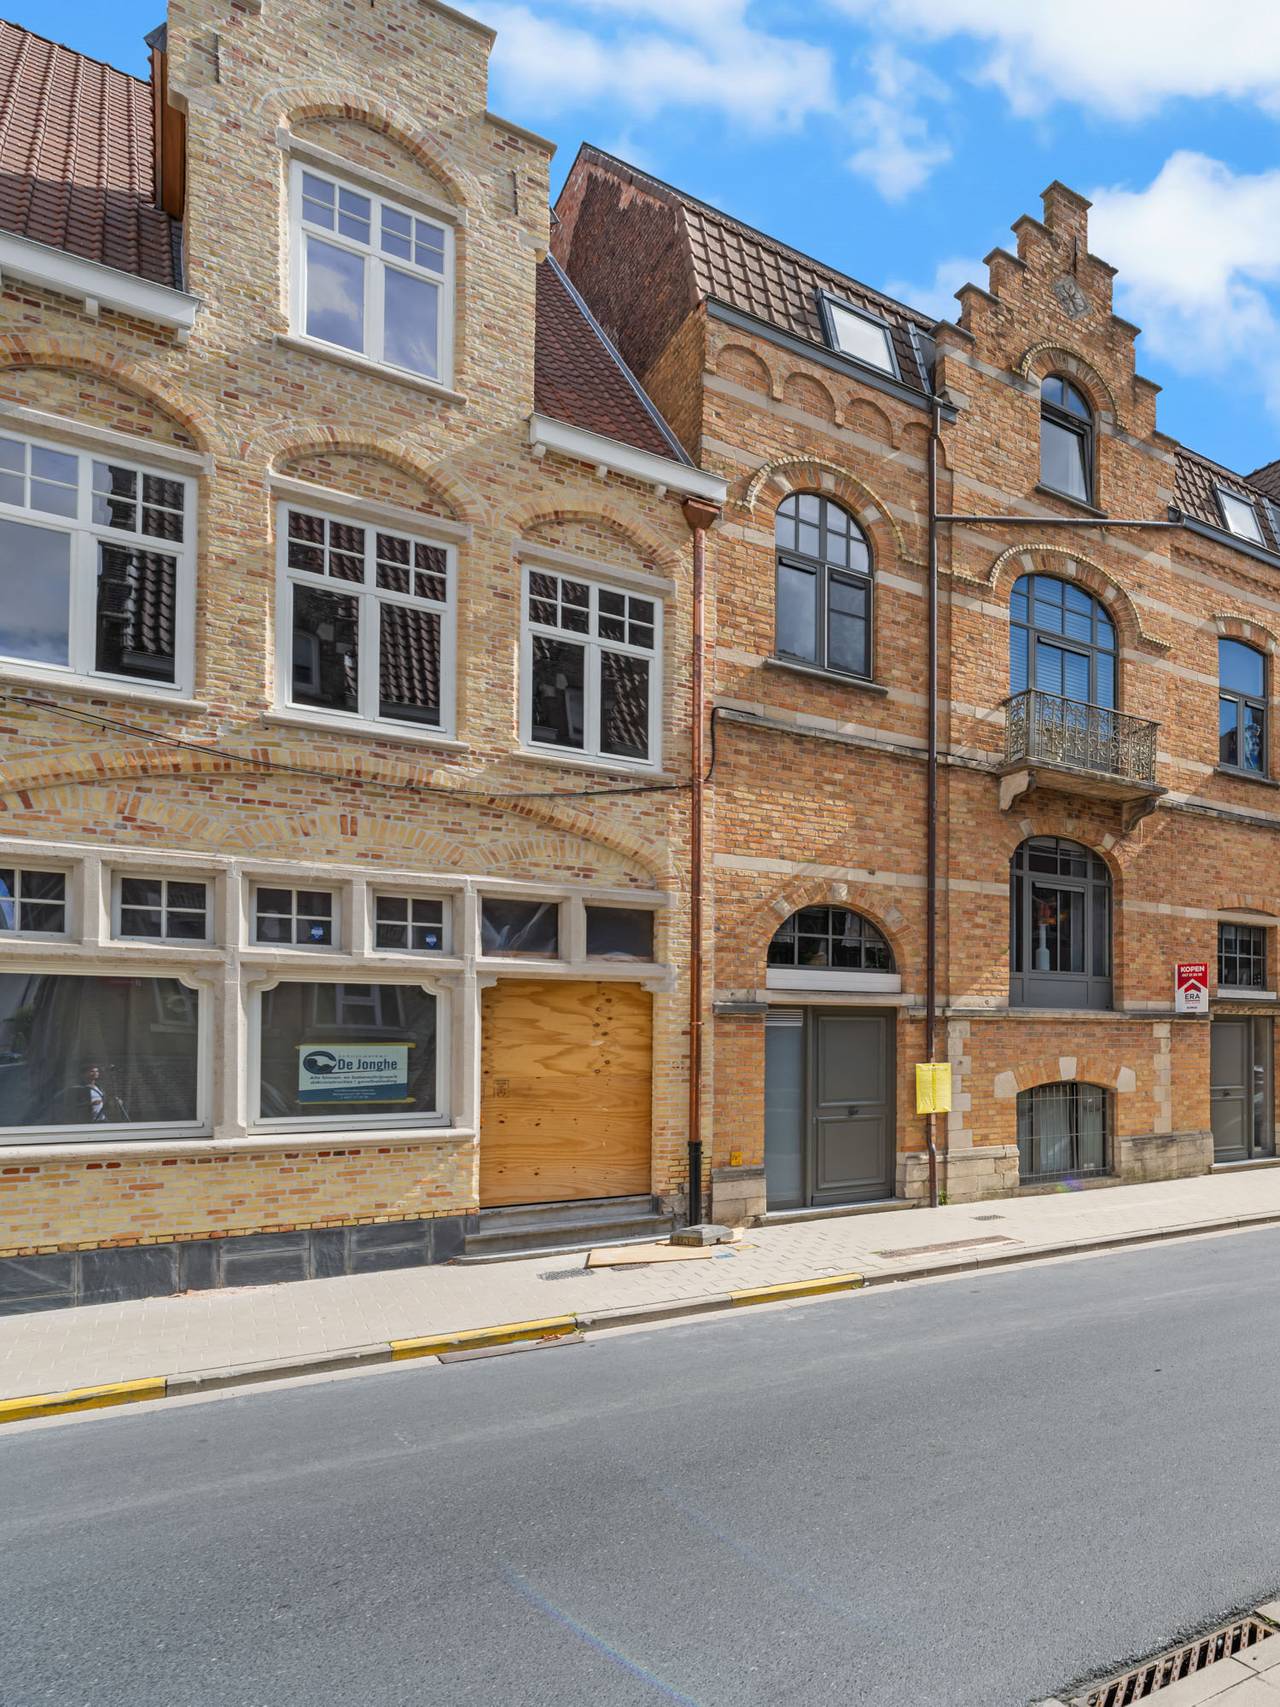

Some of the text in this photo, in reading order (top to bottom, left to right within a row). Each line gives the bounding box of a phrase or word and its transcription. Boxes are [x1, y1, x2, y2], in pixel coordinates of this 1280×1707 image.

[1180, 965, 1206, 973] KOPEN
[337, 1058, 398, 1072] De Jonghe
